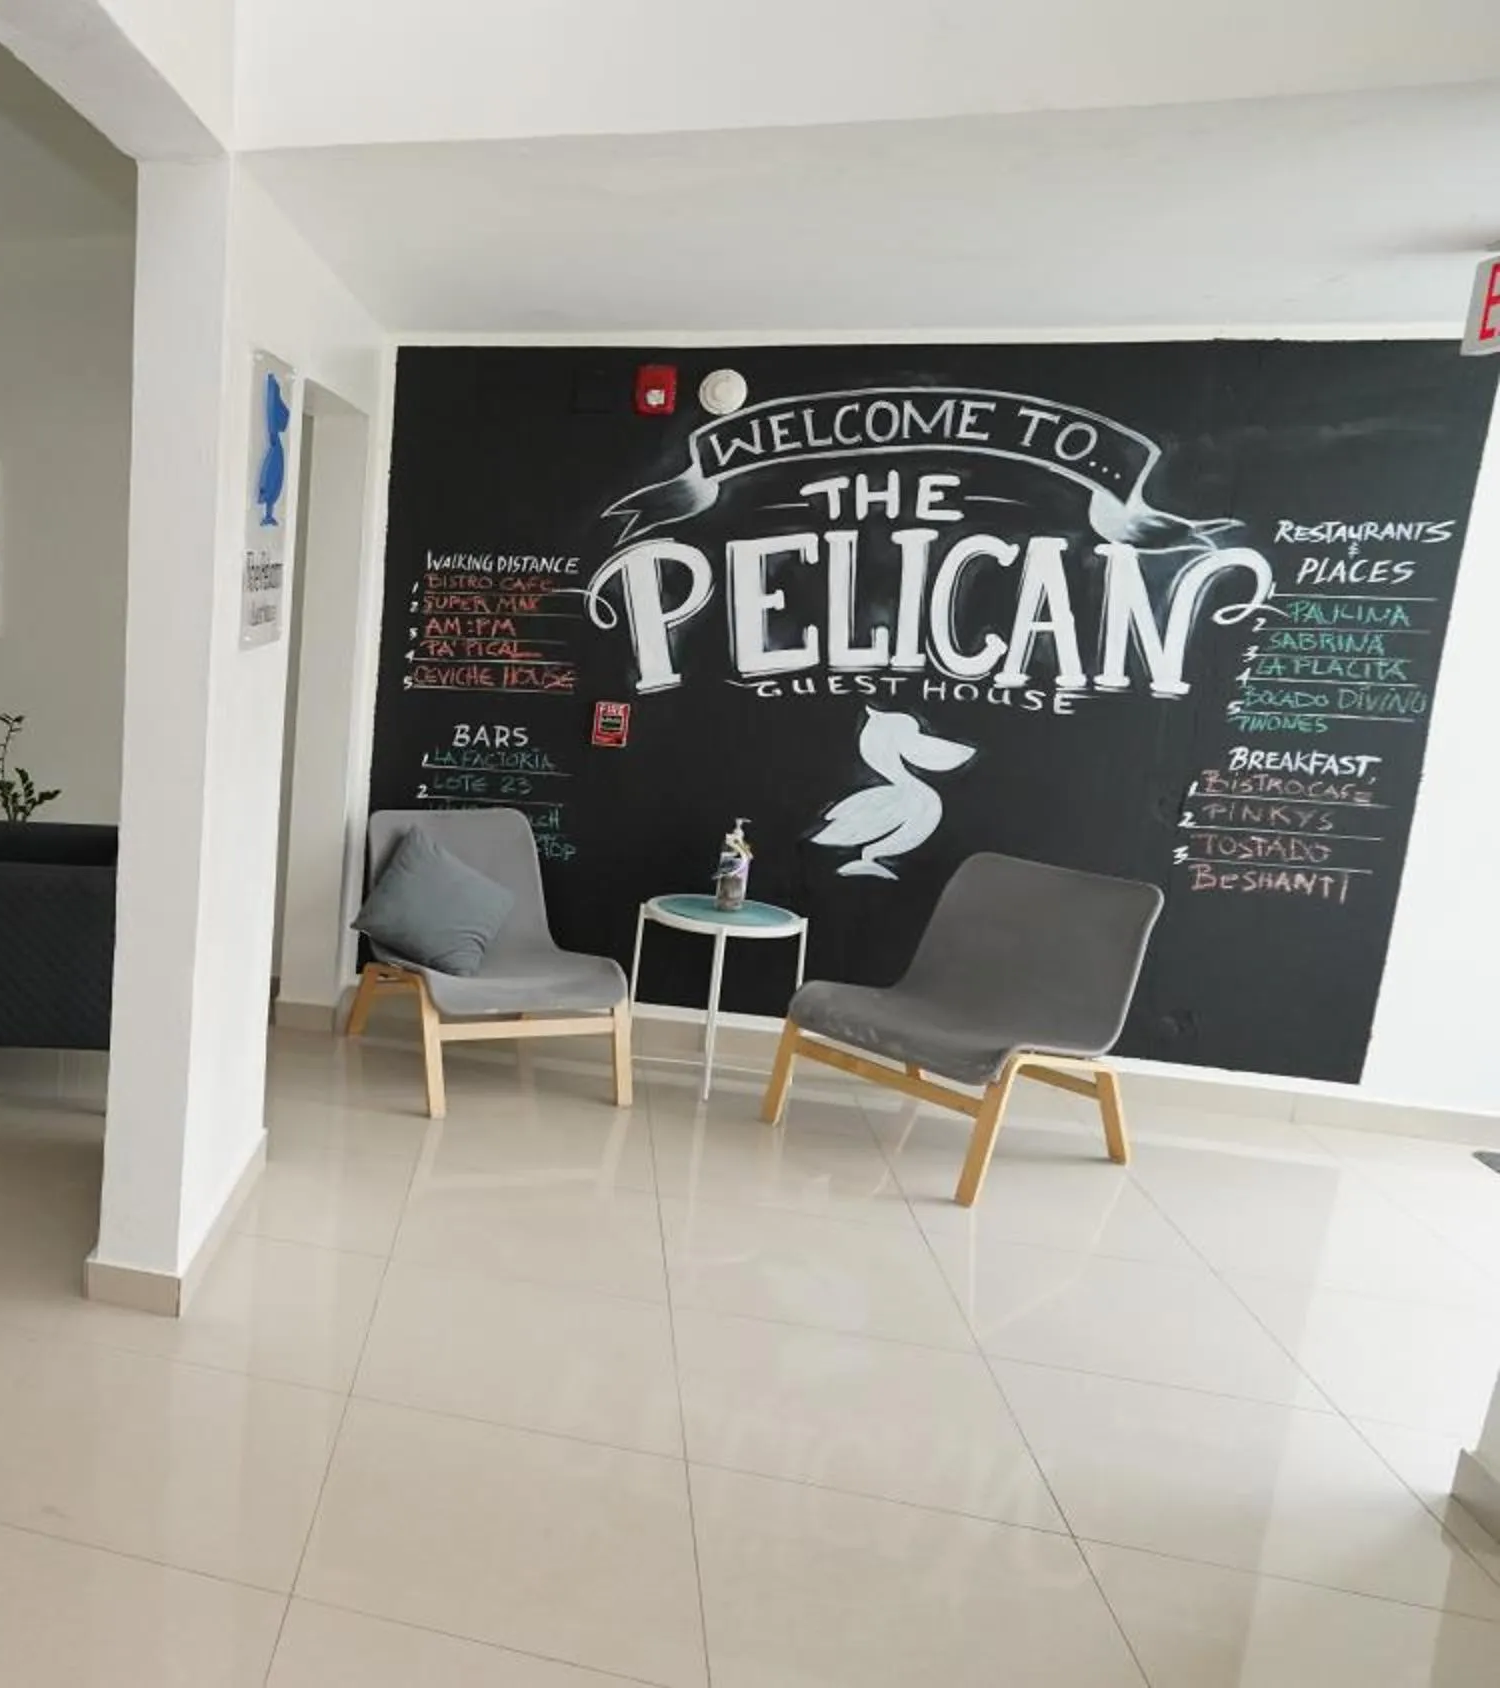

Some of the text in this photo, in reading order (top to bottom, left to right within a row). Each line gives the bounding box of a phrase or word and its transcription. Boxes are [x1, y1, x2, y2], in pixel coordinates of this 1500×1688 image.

[709, 398, 995, 468] WELCOME
[800, 470, 965, 522] THE
[1274, 519, 1455, 544] RESTAURANTS
[427, 550, 581, 574] WALKING DISTANCE
[1296, 557, 1416, 585] PLACES
[424, 574, 492, 592] BISTRO
[586, 528, 1272, 697] PELICAN
[1252, 617, 1267, 632] 2
[1242, 631, 1386, 662] 3 SABRINA
[1255, 657, 1288, 676] LA
[403, 676, 413, 690] 5
[756, 672, 1083, 715] GUEST HOUSE
[1226, 700, 1245, 715] 5
[452, 724, 530, 748] BARS
[1227, 746, 1382, 778] BREAKFAST
[417, 773, 534, 798] 2 LOTE 23
[1177, 803, 1334, 832] 2 PINKYS
[1172, 834, 1333, 864] 3 TOSTADO
